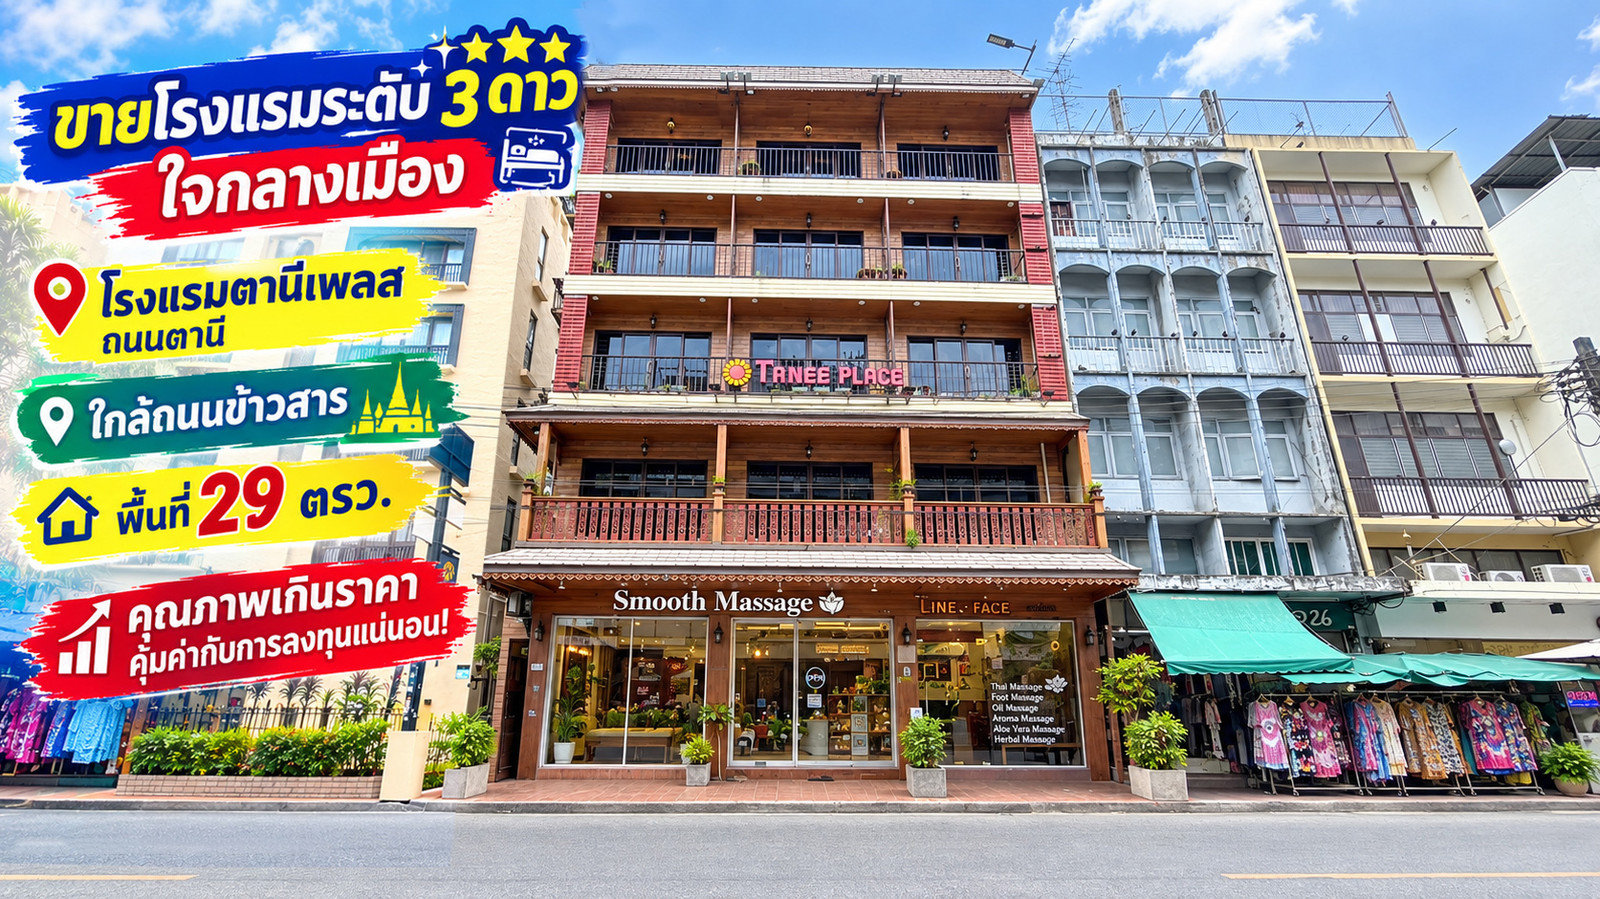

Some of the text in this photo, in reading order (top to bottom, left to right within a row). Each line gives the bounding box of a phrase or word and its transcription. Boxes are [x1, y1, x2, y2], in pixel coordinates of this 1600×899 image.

[755, 359, 904, 386] TANEE PLACE
[613, 589, 813, 617] Smooth Massage
[920, 599, 957, 615] LINE
[973, 602, 1011, 615] FACE
[1009, 682, 1043, 692] Massage
[991, 692, 1044, 703] Foot Massage
[991, 703, 1039, 713] Oil Massage
[992, 714, 1055, 724] Aroma Massage
[1032, 725, 1066, 735] Massage
[994, 735, 1056, 745] Herbal Massage
